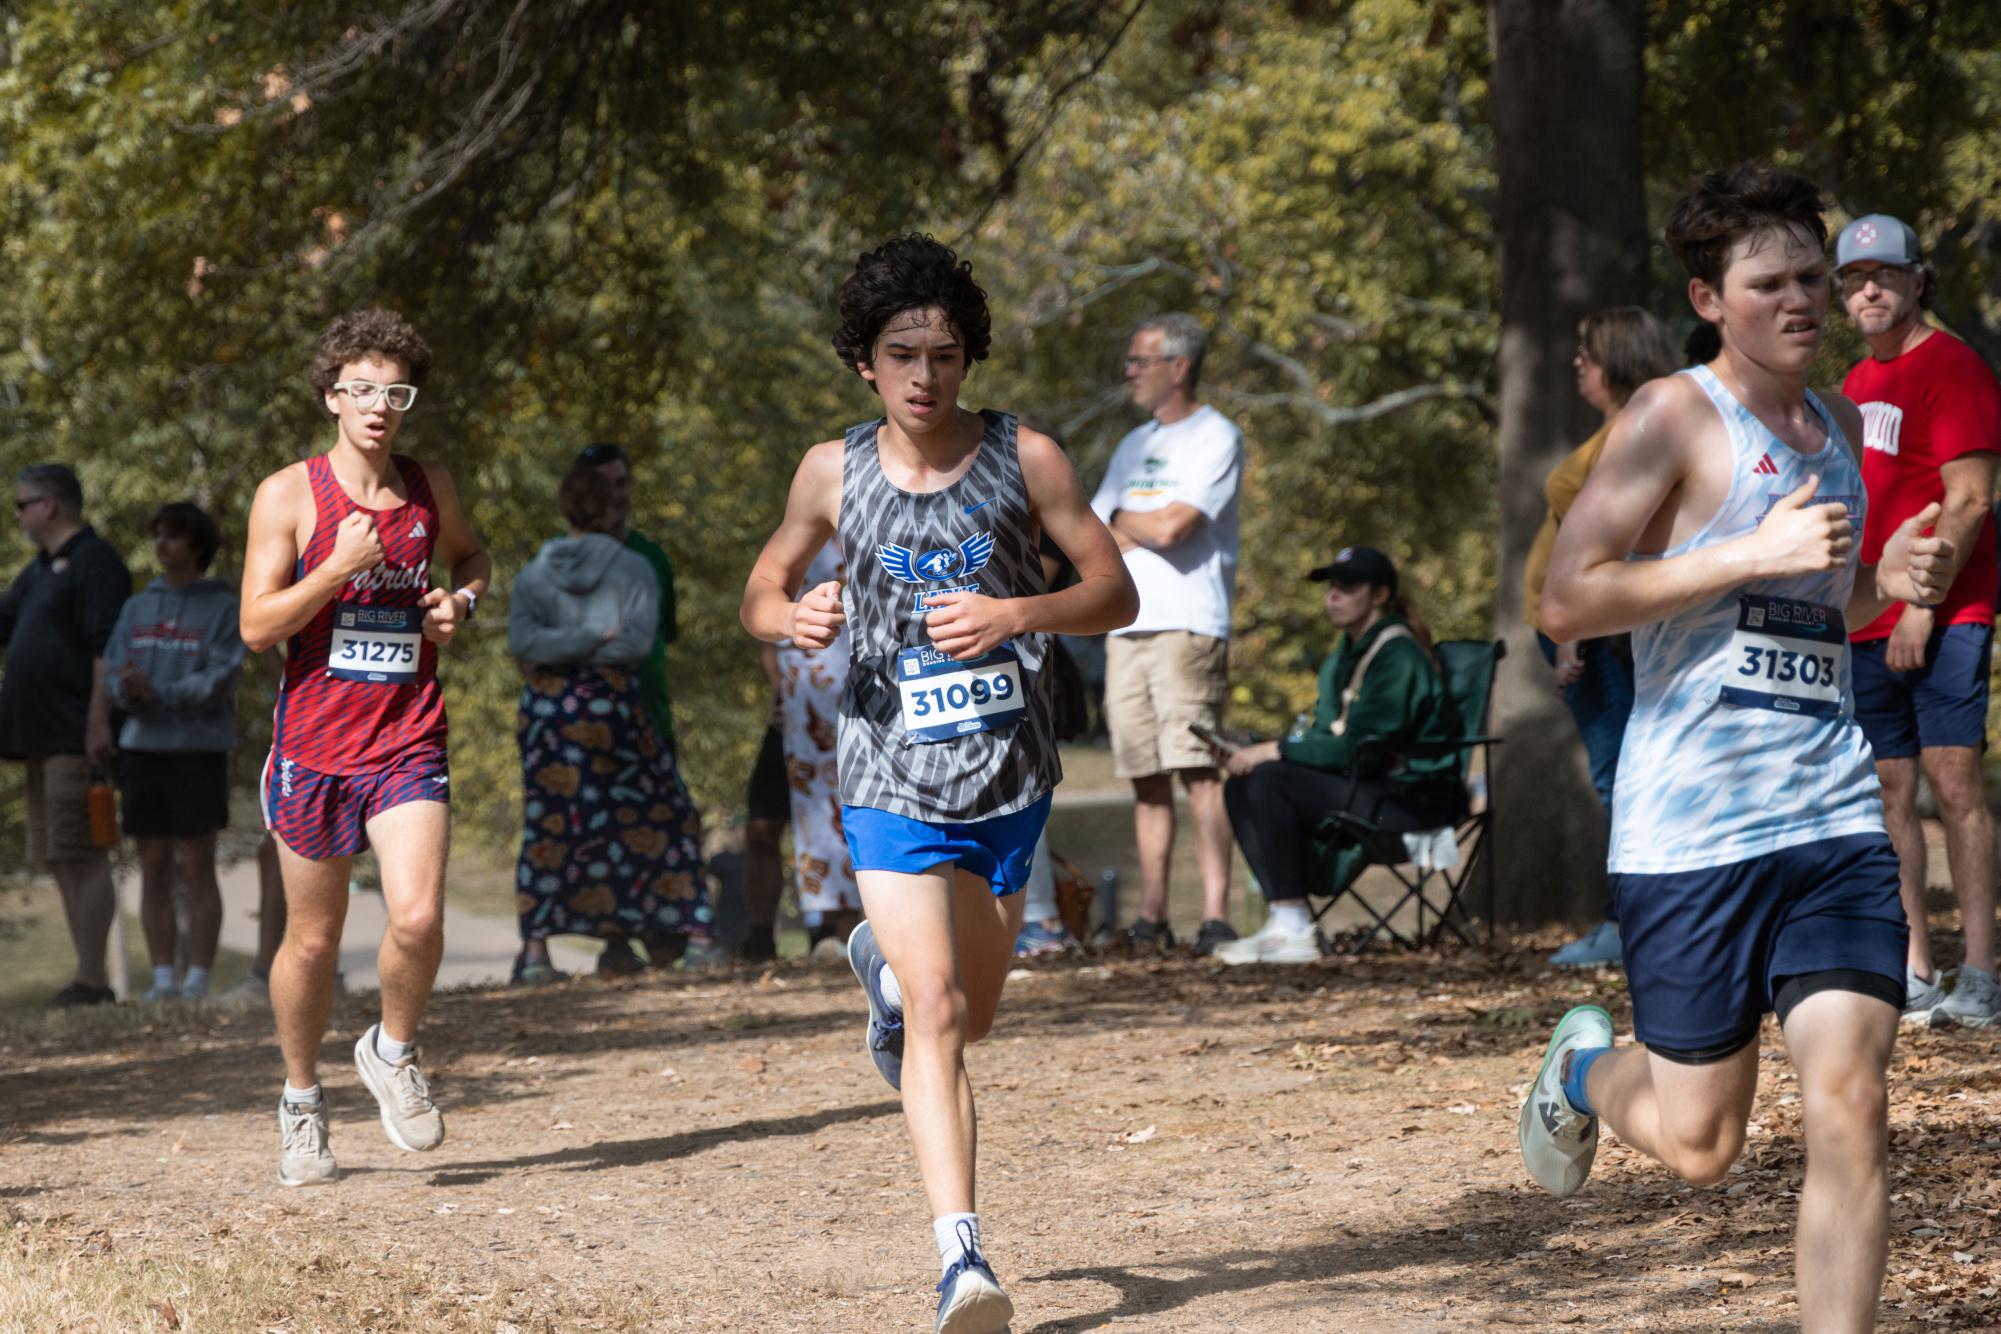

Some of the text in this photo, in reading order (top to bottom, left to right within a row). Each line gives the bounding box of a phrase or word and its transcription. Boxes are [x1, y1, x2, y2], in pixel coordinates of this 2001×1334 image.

[350, 558, 429, 591] atriot
[357, 609, 376, 620] BIG
[378, 610, 407, 623] RIVER
[1768, 602, 1826, 623] BIG RIVER
[341, 639, 414, 663] 31275
[920, 649, 944, 662] BIG
[1738, 645, 1834, 688] 31303
[911, 673, 1015, 717] 31099
